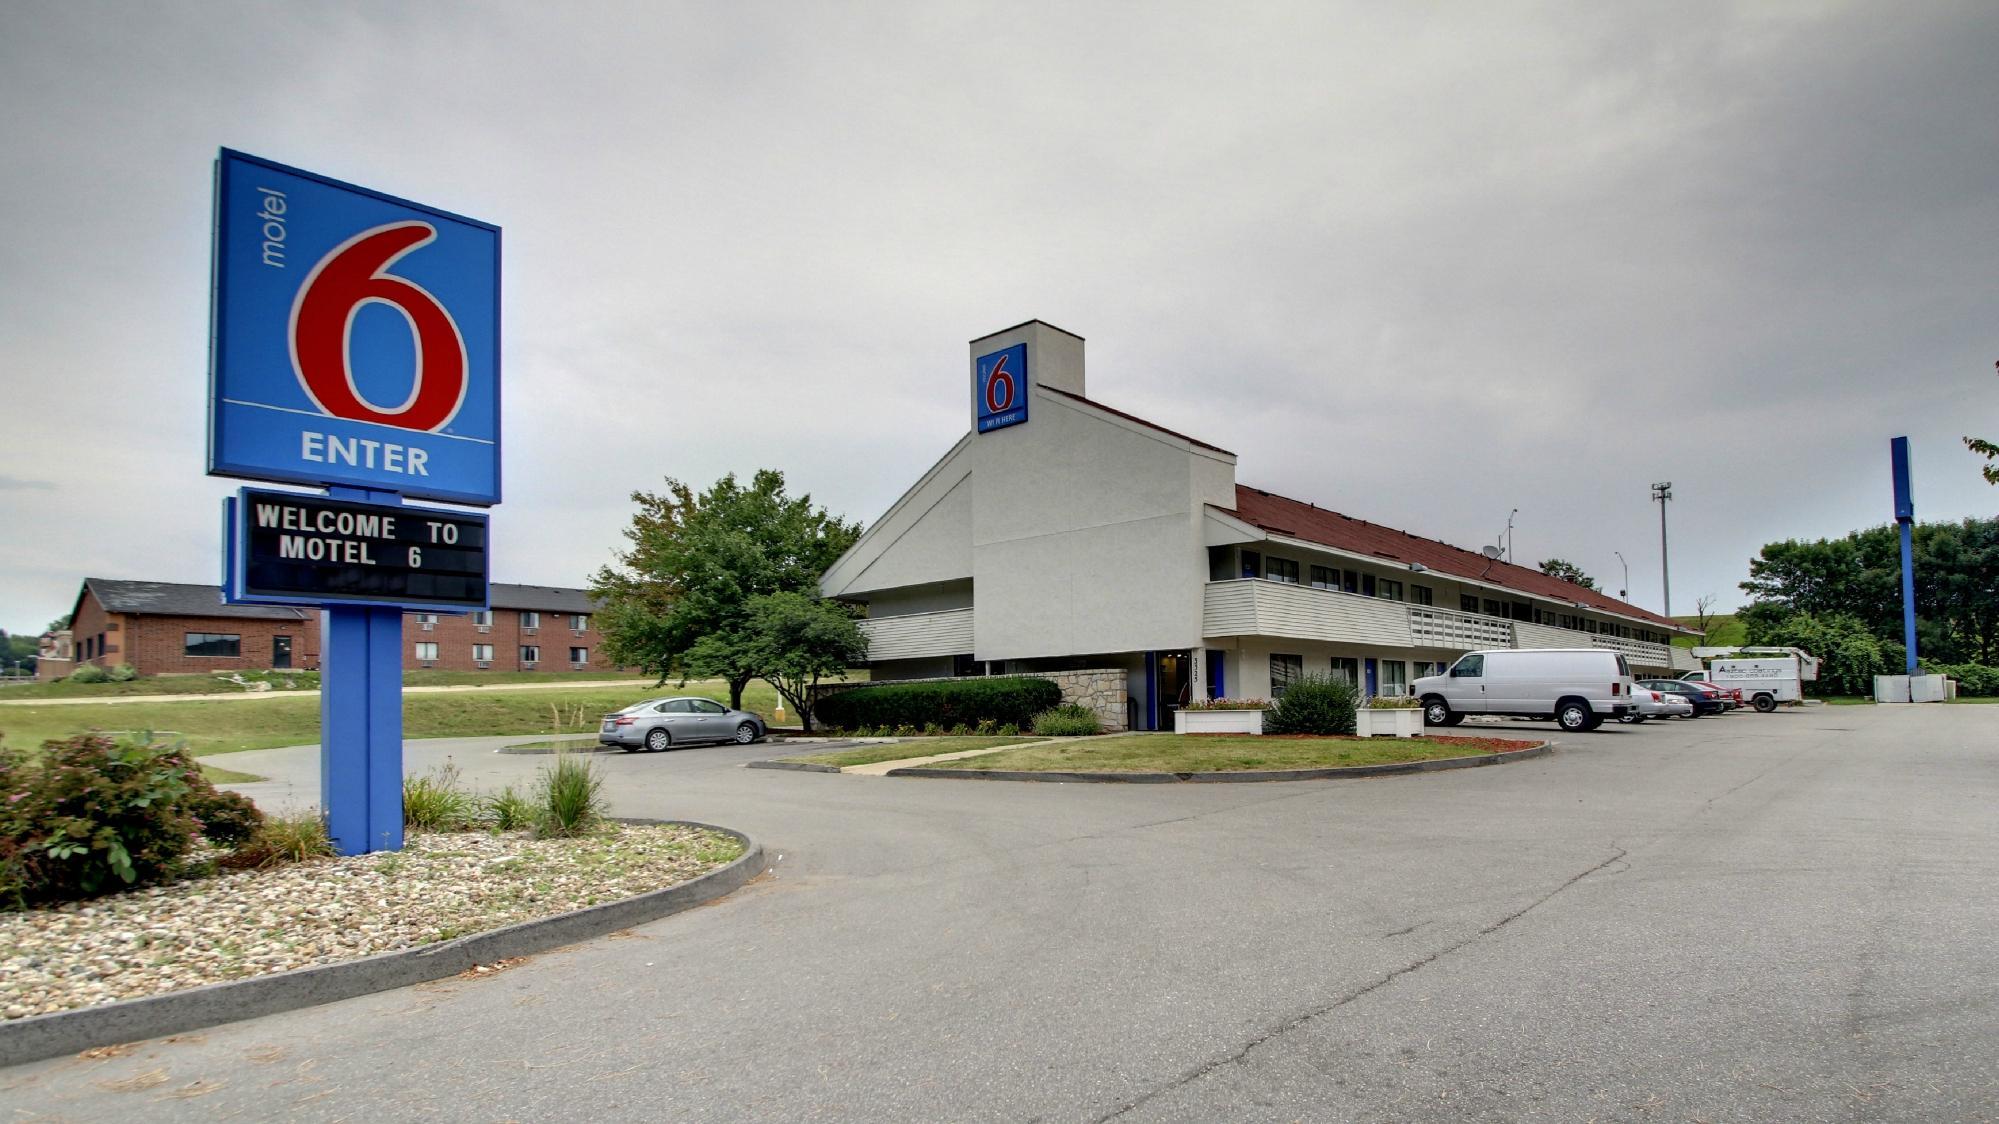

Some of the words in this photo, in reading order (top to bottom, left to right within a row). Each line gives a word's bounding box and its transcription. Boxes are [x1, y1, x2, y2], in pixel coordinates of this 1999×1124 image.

[256, 187, 287, 268] motel
[288, 220, 469, 433] 6
[985, 354, 1015, 414] 6
[1001, 414, 1016, 424] HERE
[301, 430, 429, 476] ENTER
[256, 503, 396, 540] WELCOME
[427, 521, 459, 545] TO
[279, 534, 376, 565] MOTEL
[408, 546, 422, 568] 6
